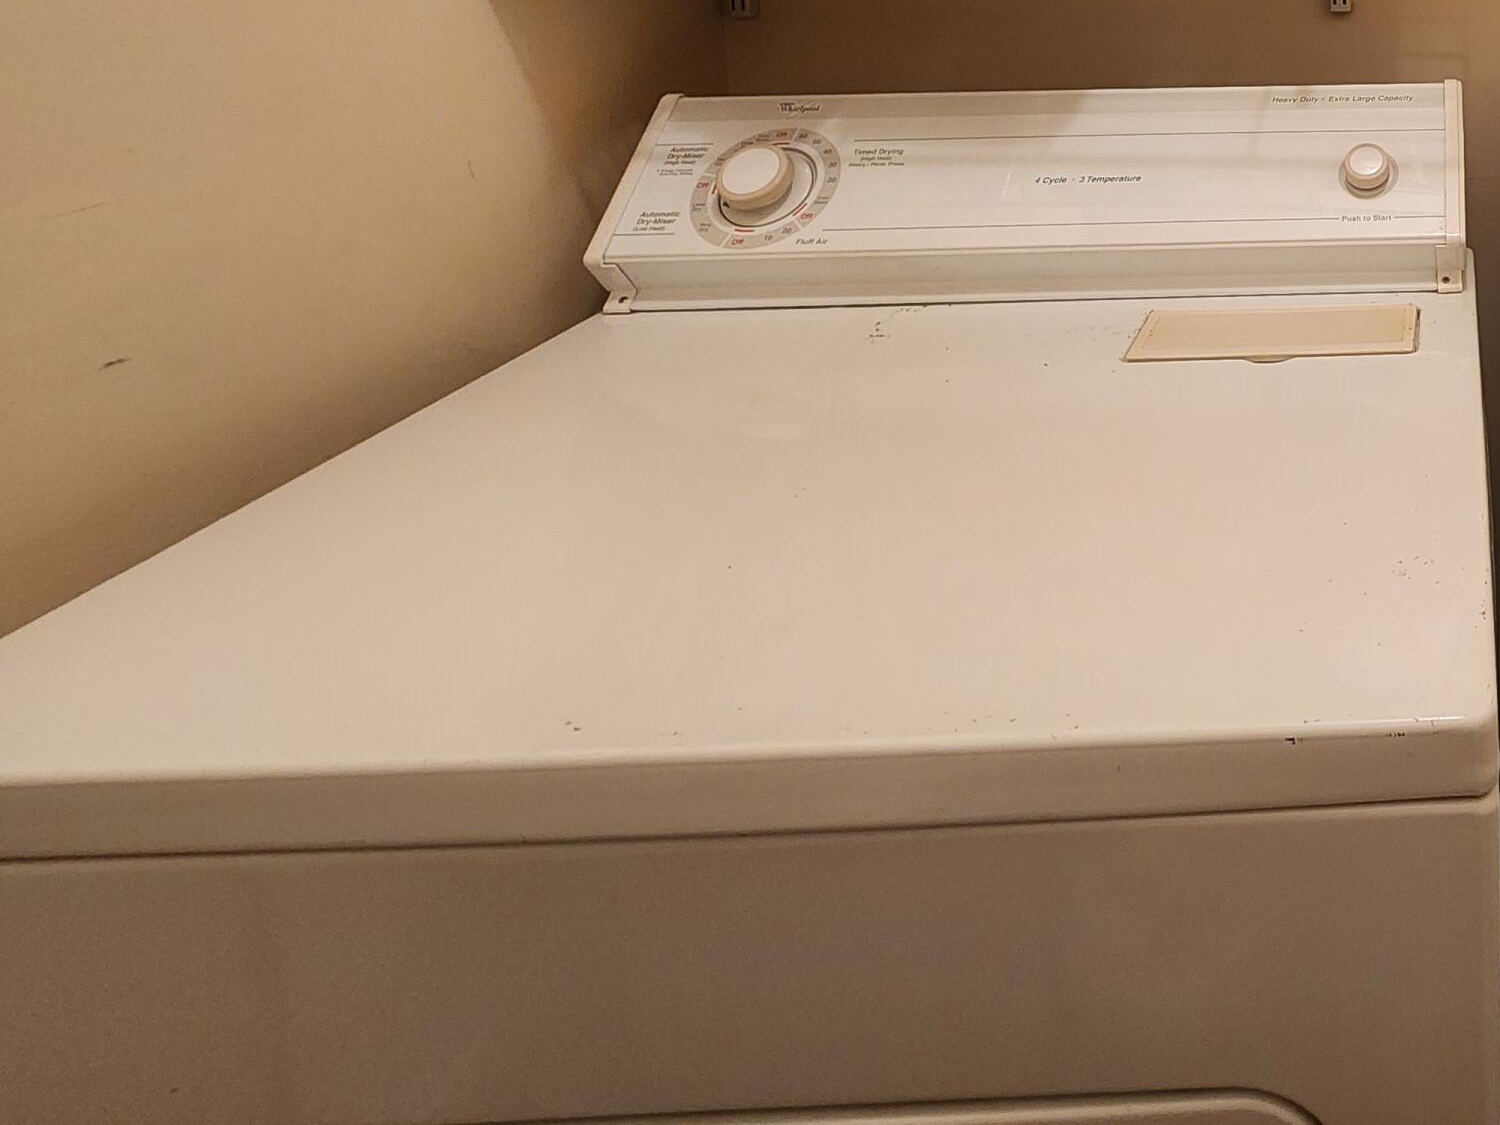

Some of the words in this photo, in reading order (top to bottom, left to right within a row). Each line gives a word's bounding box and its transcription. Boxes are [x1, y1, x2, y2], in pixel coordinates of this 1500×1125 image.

[1272, 96, 1298, 104] Heavy
[1299, 96, 1319, 104] Duty
[1328, 95, 1350, 103] Extra
[1352, 95, 1376, 103] Large
[1378, 94, 1414, 103] Capacity
[878, 148, 904, 156] Drying
[1042, 176, 1068, 185] Cycle
[1087, 175, 1142, 184] Temperature
[1373, 214, 1392, 222] Start
[731, 238, 745, 246] Off
